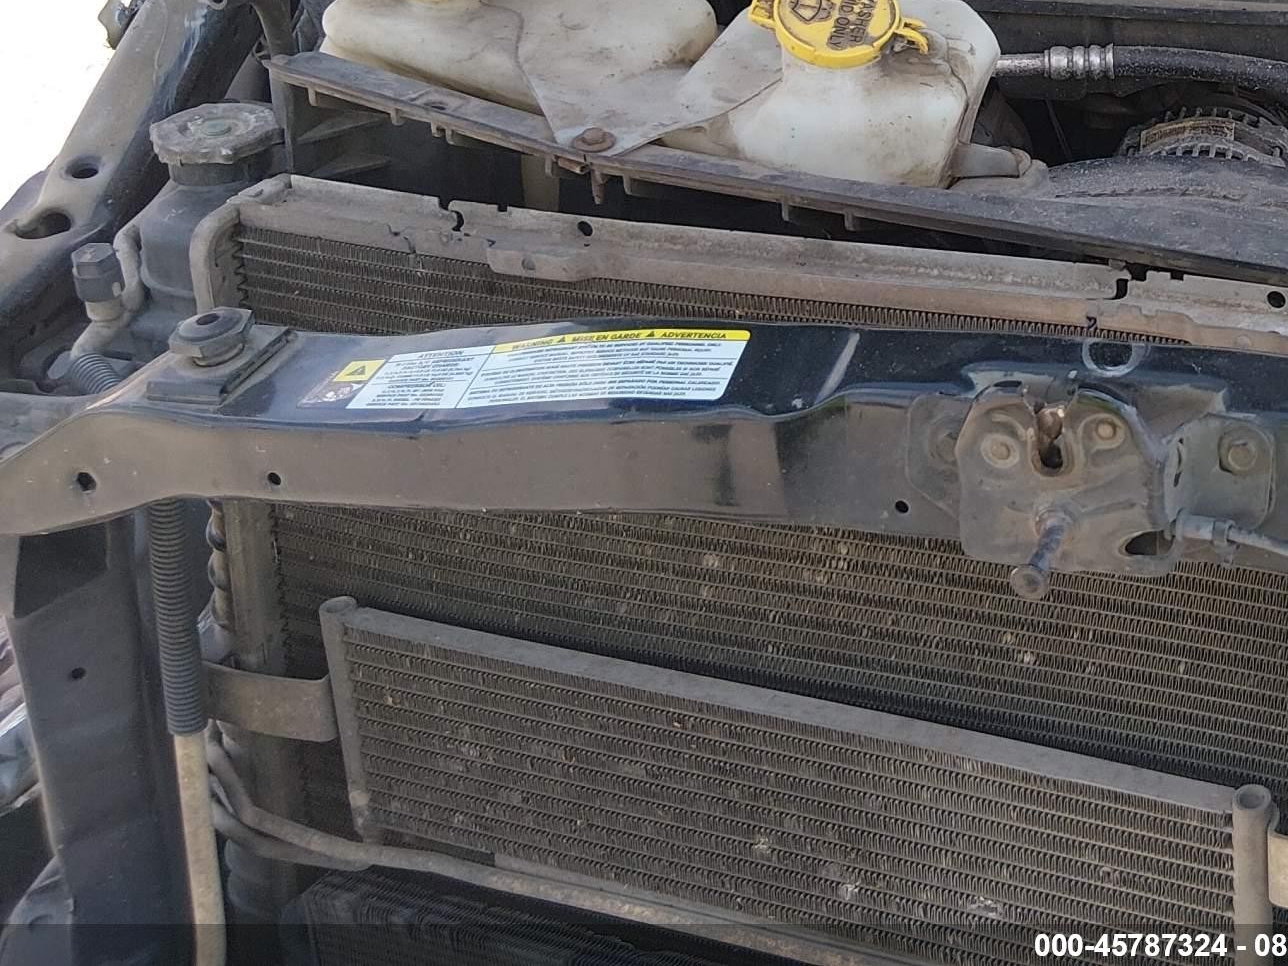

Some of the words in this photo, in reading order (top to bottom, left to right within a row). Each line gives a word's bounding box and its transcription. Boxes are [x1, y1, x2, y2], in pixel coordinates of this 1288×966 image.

[826, 16, 851, 50] ONLY
[594, 334, 609, 342] EN
[610, 332, 641, 340] GARDE
[661, 331, 727, 339] ADVERTENCIA
